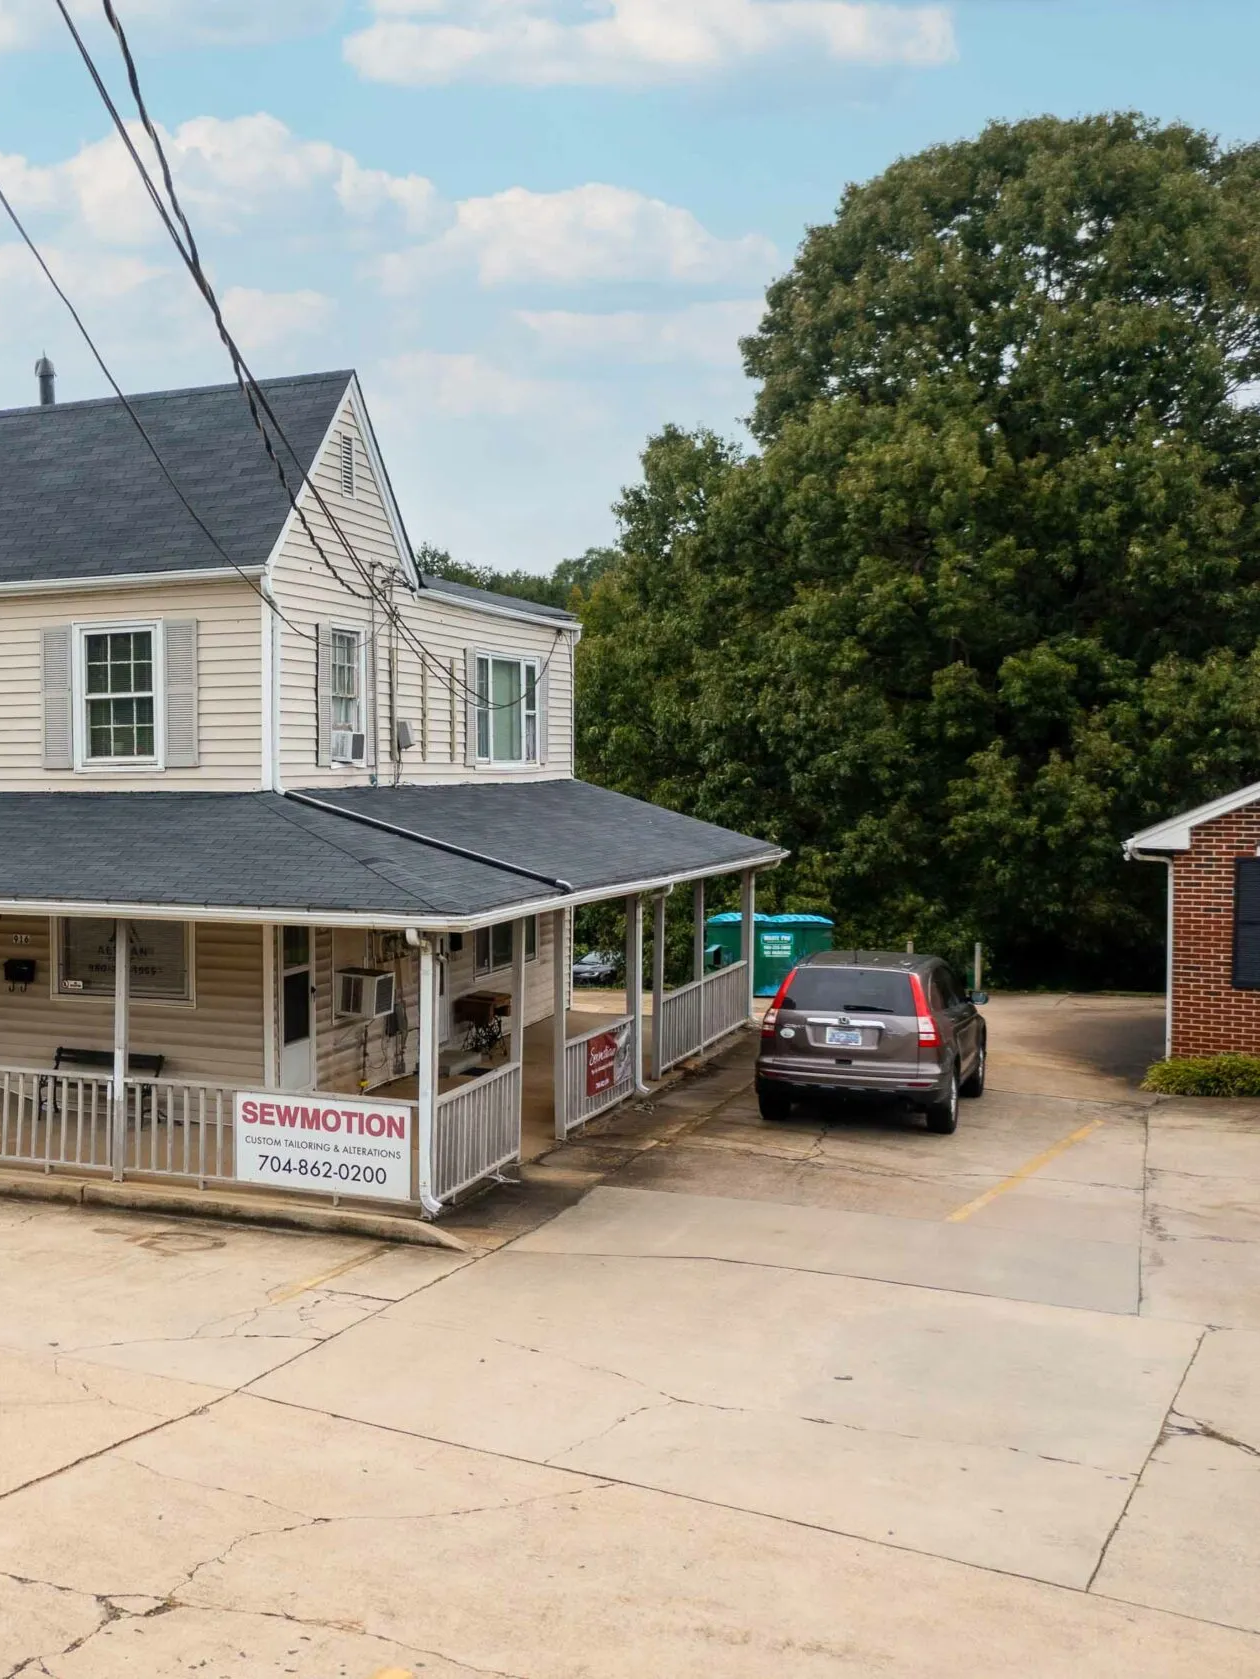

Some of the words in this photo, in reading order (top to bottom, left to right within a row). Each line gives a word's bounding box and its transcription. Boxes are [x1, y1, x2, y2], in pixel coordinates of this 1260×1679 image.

[241, 1101, 405, 1139] SEWMOTION
[245, 1135, 282, 1147] CUSTOM
[284, 1139, 331, 1153] TAILORING
[333, 1144, 340, 1153] &
[342, 1146, 402, 1159] ALTERATIONS
[258, 1154, 387, 1185] 704-862-0200
